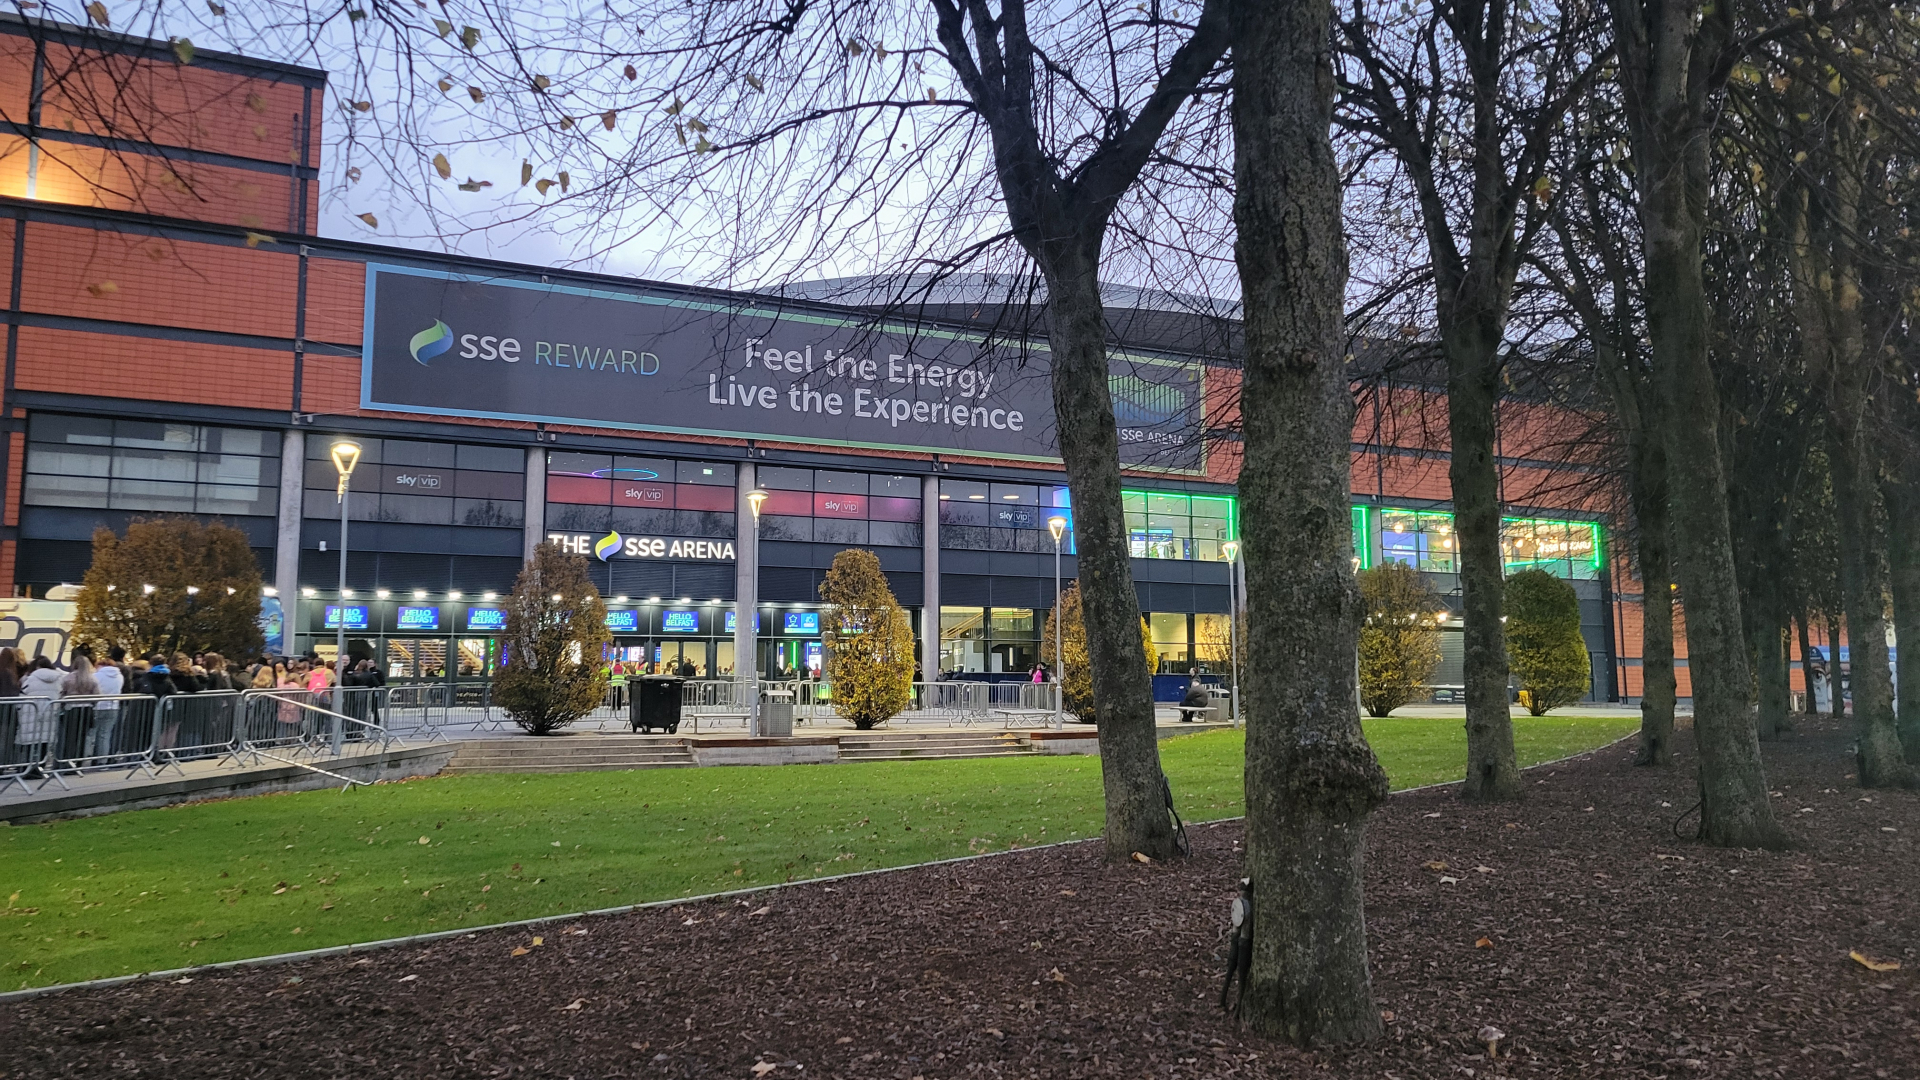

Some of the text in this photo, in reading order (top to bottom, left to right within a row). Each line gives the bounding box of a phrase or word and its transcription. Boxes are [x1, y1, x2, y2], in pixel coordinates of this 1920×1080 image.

[459, 333, 661, 376] sse REWARD
[745, 338, 996, 399] Feel the Energy
[708, 373, 1025, 431] Live the Experience
[1121, 428, 1144, 442] sse
[396, 474, 439, 488] sky vip
[625, 488, 661, 501] sky vip
[824, 500, 857, 513] sky vip
[999, 511, 1028, 523] sky vip
[547, 534, 735, 560] THE sse ARENA
[333, 608, 360, 616] HLLO
[405, 609, 432, 617] HELLO
[329, 615, 364, 623] BEFAST
[401, 615, 435, 623] BELFAST
[471, 616, 504, 624] BELFAST
